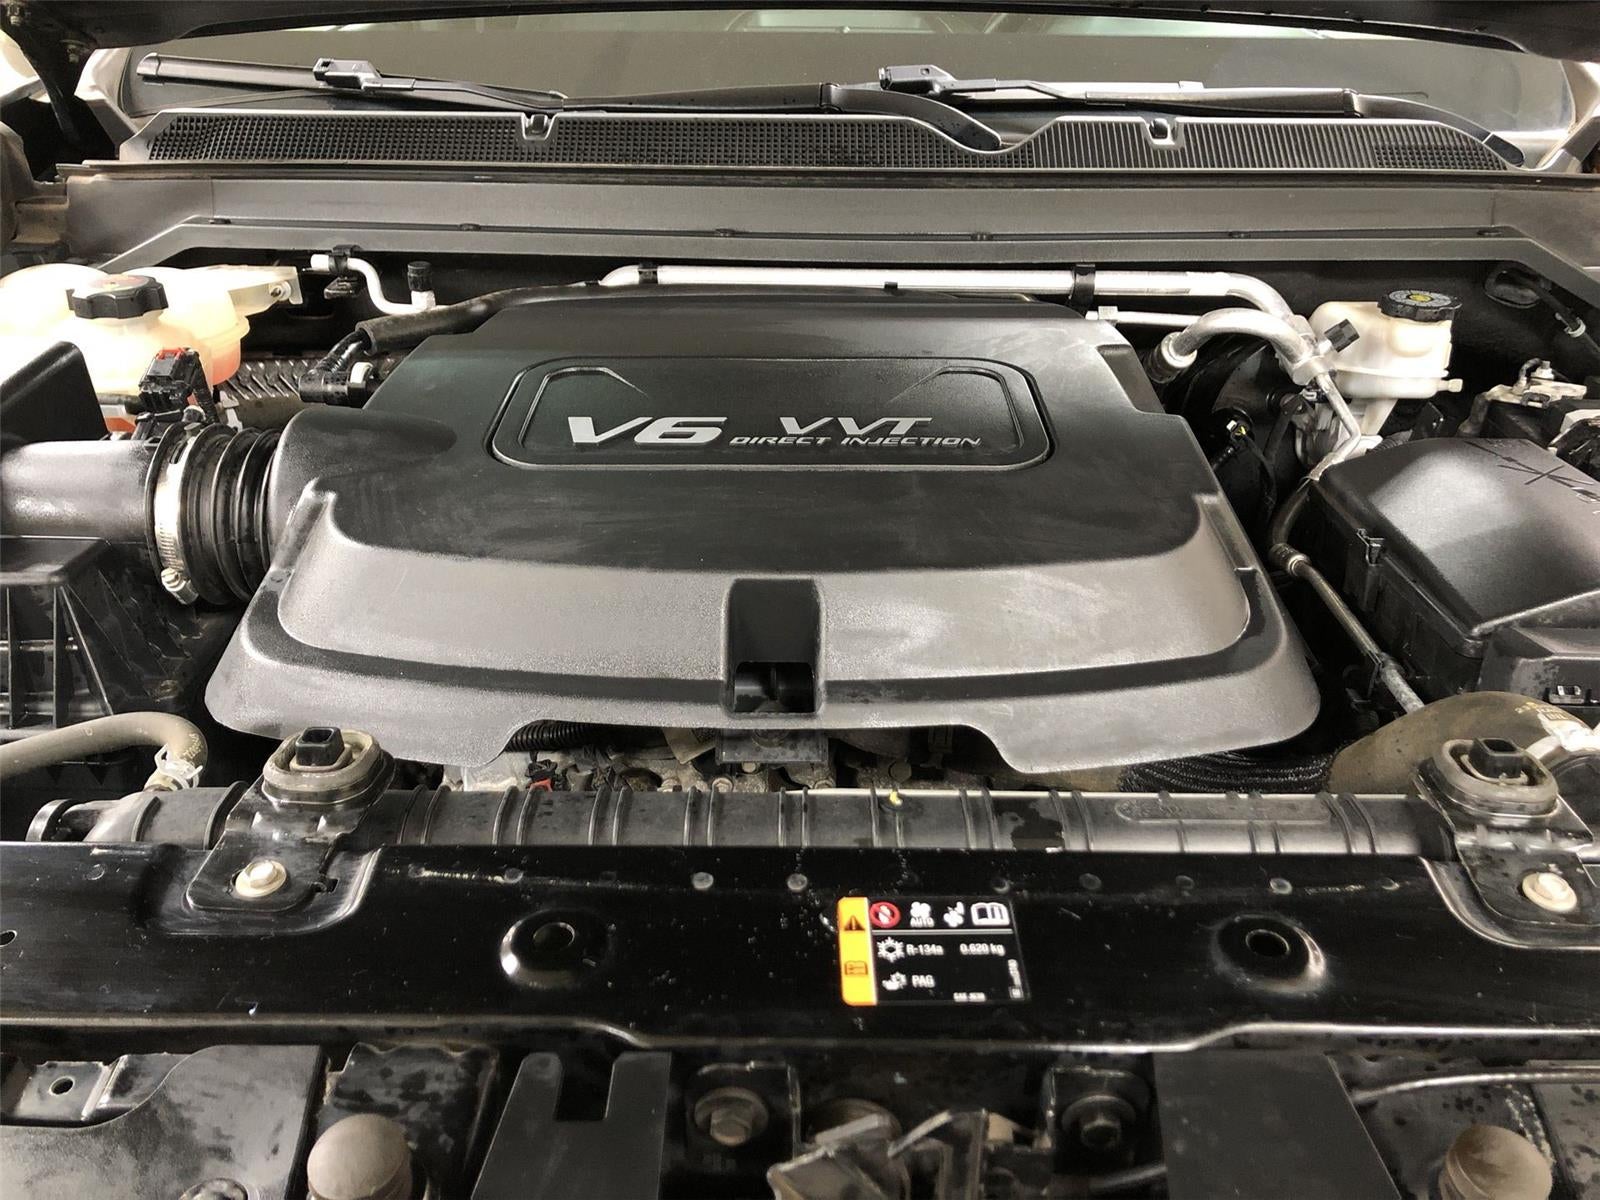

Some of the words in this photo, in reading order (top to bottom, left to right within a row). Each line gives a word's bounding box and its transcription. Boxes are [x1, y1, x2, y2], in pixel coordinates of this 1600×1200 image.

[567, 416, 728, 445] V6
[779, 416, 933, 436] VVT
[729, 436, 831, 446] DIRECT
[840, 436, 981, 447] INJECTION
[906, 944, 944, 956] R-134a
[959, 943, 990, 955] 0.620
[990, 943, 1006, 957] kg
[911, 975, 936, 987] PAG
